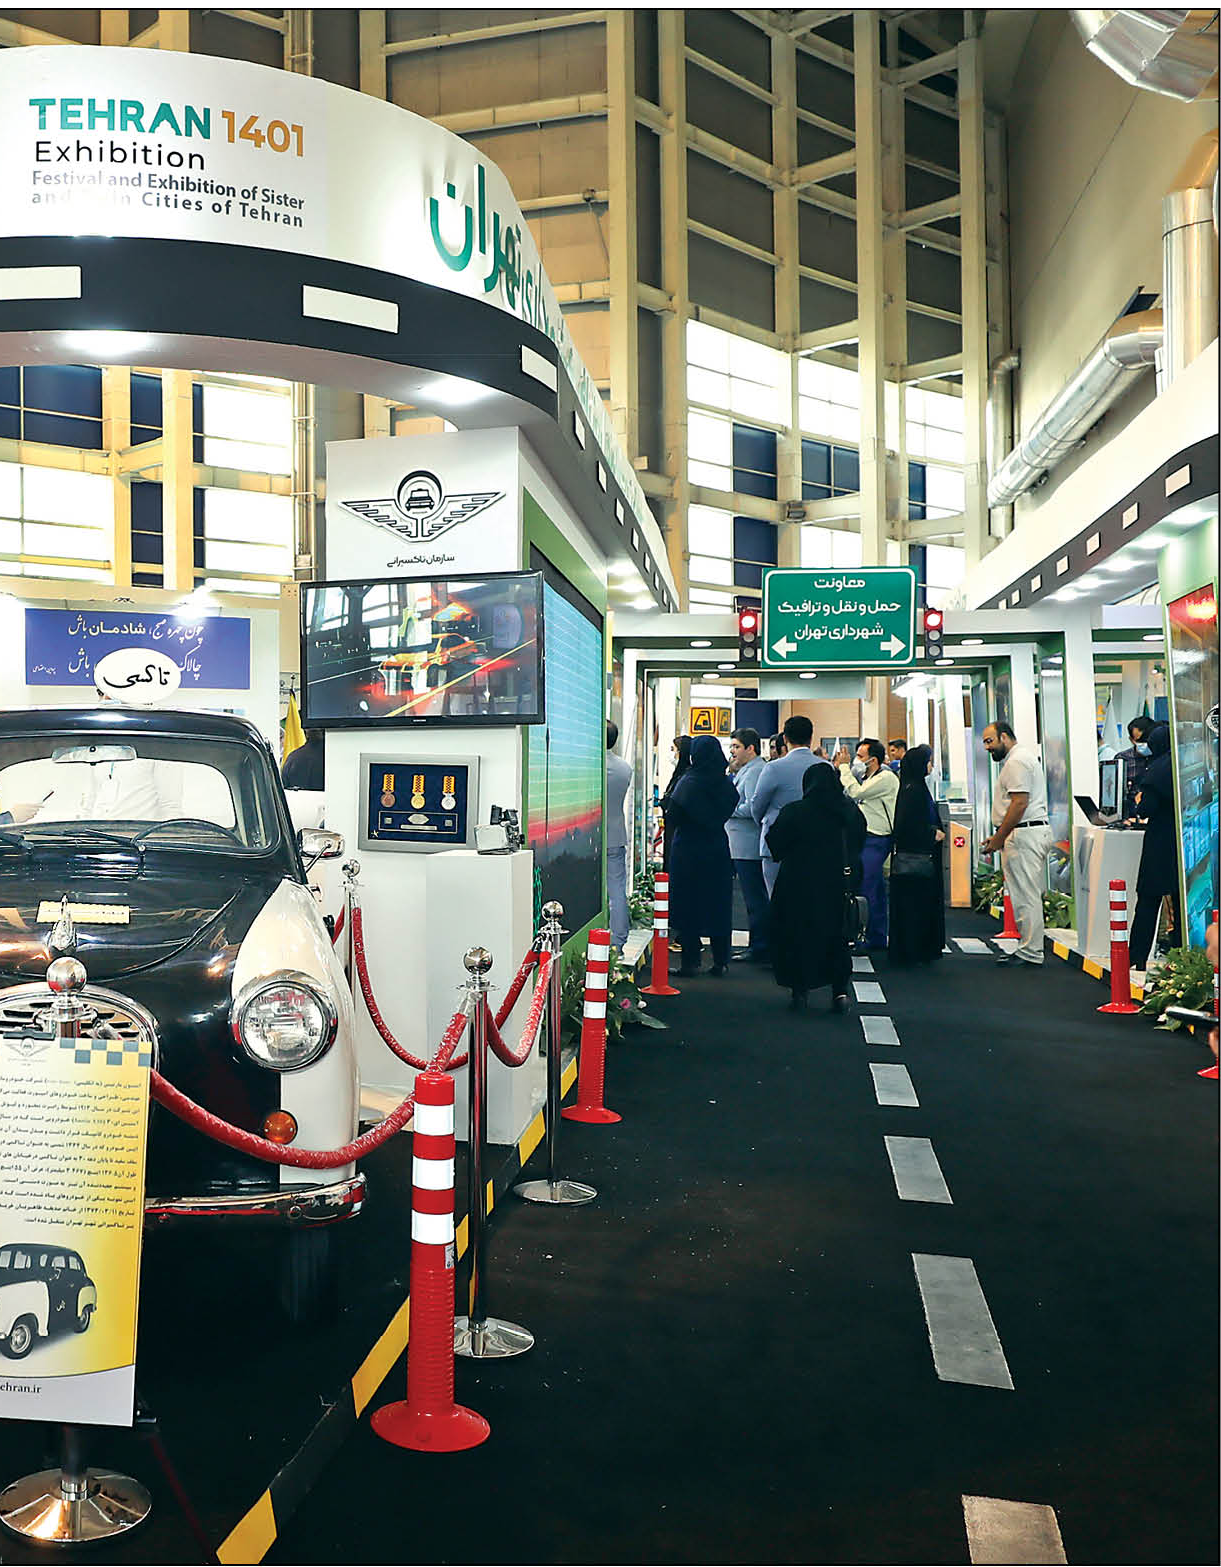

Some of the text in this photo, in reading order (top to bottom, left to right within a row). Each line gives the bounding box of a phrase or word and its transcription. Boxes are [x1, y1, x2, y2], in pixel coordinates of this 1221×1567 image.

[28, 97, 304, 157] TEHRAN 1401
[35, 139, 205, 170] Exhibition
[32, 170, 305, 210] Festival and Exhibition of Sister
[142, 191, 203, 211] Cities
[211, 200, 232, 215] of
[239, 202, 303, 228] Tehran
[429, 163, 522, 312] تهران
[426, 553, 455, 565] سازمان
[814, 575, 866, 592] معاونت
[777, 599, 901, 616] حمل و نقل و ترافیک
[68, 613, 88, 640] باش
[88, 621, 146, 636] شادمان
[185, 625, 204, 644] چون
[794, 622, 884, 641] شهرداری تهران
[68, 647, 91, 678] باش
[103, 664, 171, 689] تاکسی
